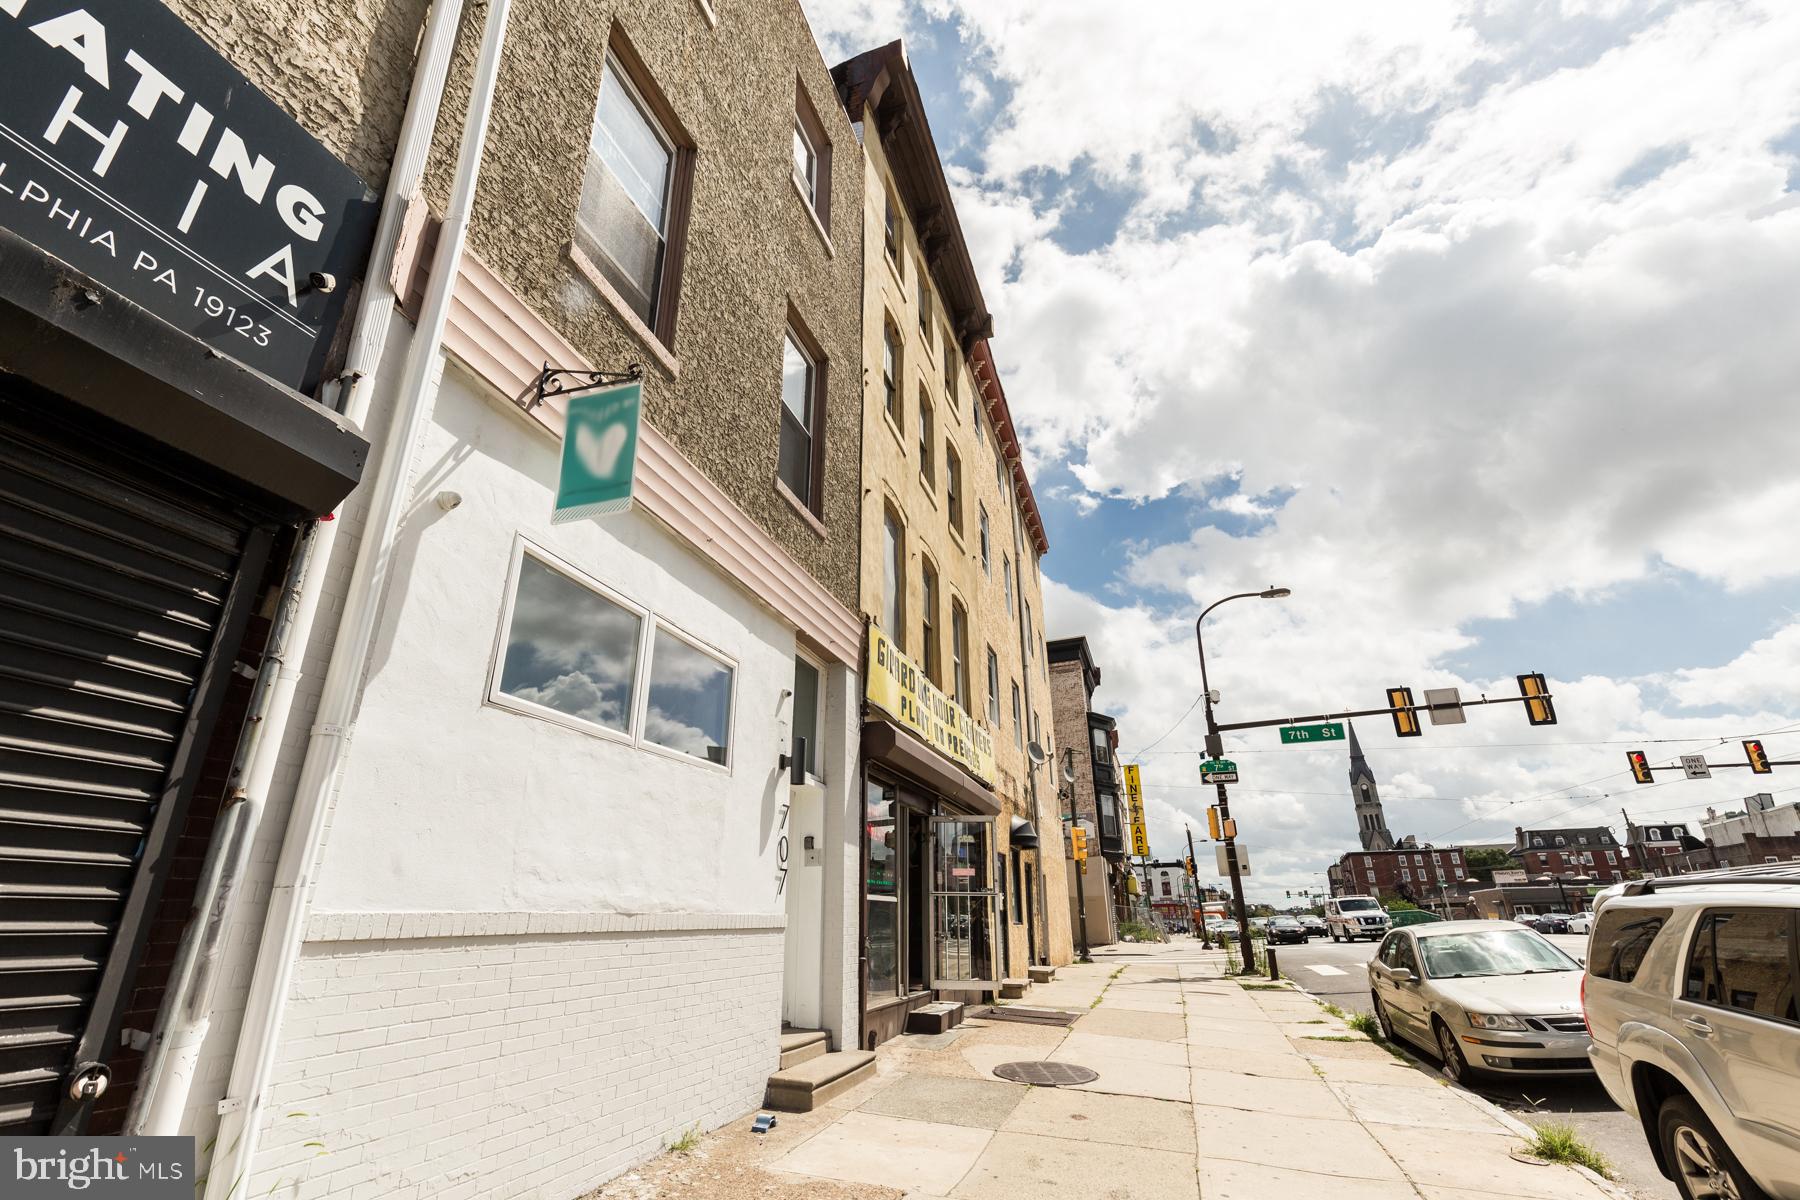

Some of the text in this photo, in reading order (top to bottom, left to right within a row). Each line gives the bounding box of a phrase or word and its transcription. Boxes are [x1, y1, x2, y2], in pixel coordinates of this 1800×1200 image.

[133, 251, 178, 294] PA
[193, 286, 272, 347] 19123
[877, 637, 916, 694] GIRARD
[932, 693, 956, 729] HOUR
[958, 712, 992, 758] CNERS
[1288, 728, 1337, 740] 7th St
[778, 803, 790, 895] 707
[1128, 766, 1145, 855] FINE FARE
